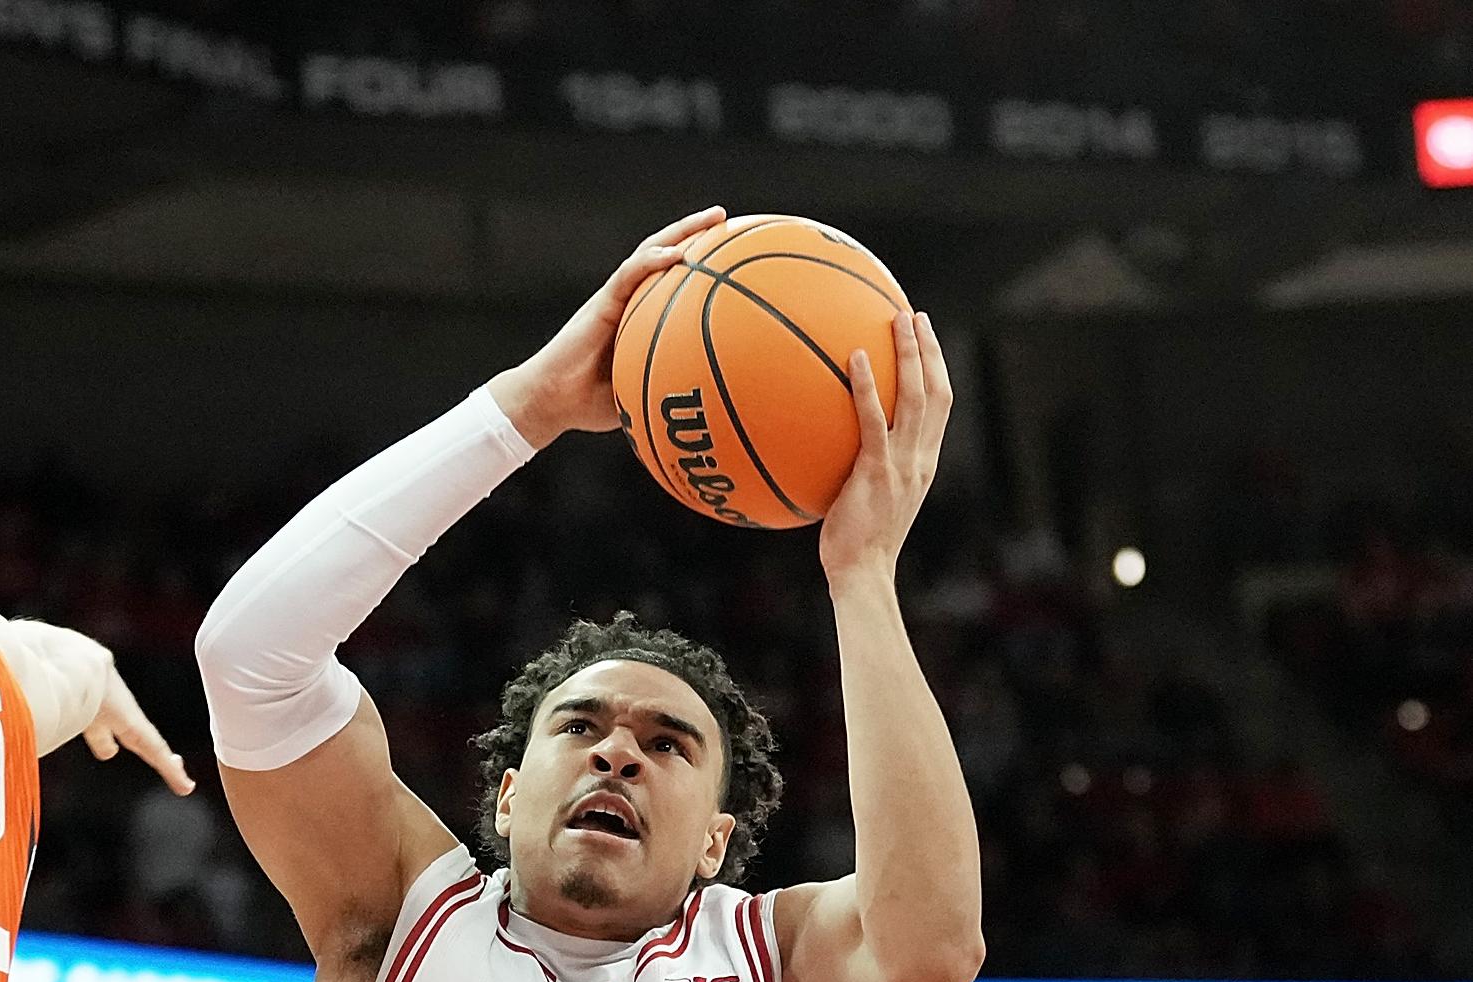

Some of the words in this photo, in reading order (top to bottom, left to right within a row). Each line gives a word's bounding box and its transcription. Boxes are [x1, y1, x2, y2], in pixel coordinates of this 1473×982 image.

[302, 53, 503, 117] FOUR
[559, 71, 722, 132] 1941
[768, 83, 954, 150] 2000
[660, 387, 759, 528] Wilso
